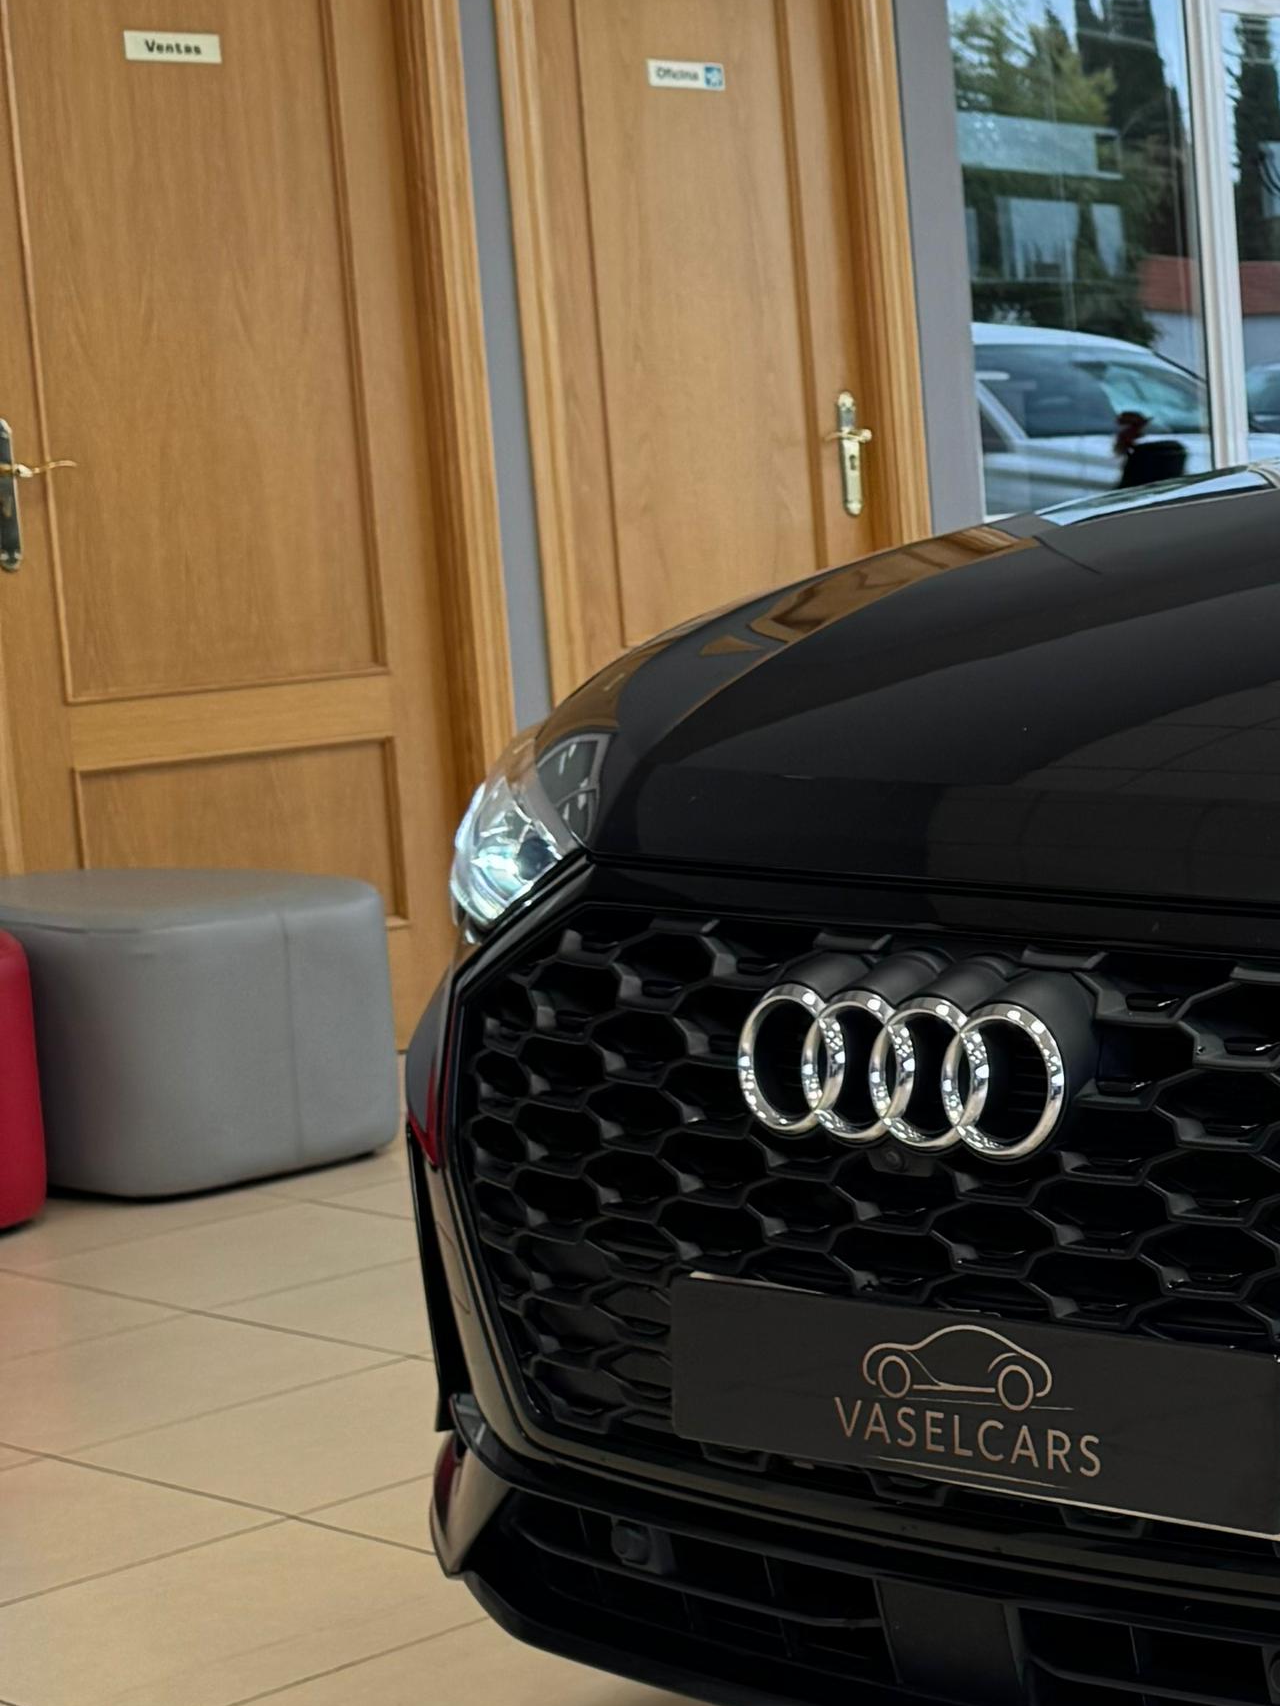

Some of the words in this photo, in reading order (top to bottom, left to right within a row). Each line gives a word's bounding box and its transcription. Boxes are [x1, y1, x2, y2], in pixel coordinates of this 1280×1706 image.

[143, 38, 203, 56] Ventas
[655, 66, 700, 82] Oficina
[833, 1396, 1101, 1477] VASELCARS
